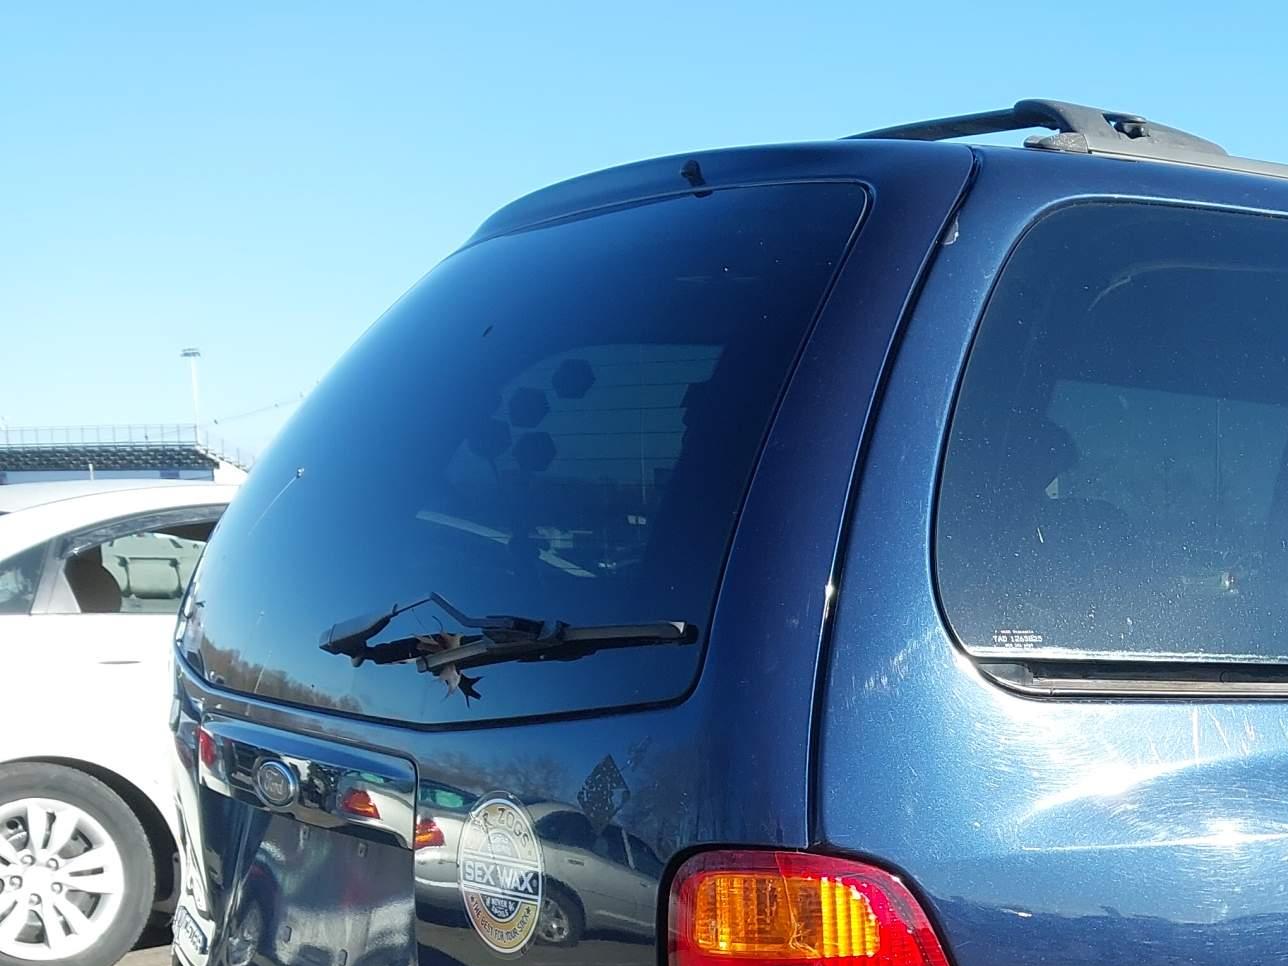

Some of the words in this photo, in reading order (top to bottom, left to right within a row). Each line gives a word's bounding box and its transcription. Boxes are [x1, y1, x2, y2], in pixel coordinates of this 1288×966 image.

[263, 769, 285, 796] Ford
[497, 807, 530, 848] ZOGS
[465, 861, 496, 885] SEX
[496, 865, 534, 893] WAX
[480, 917, 494, 937] BEST
